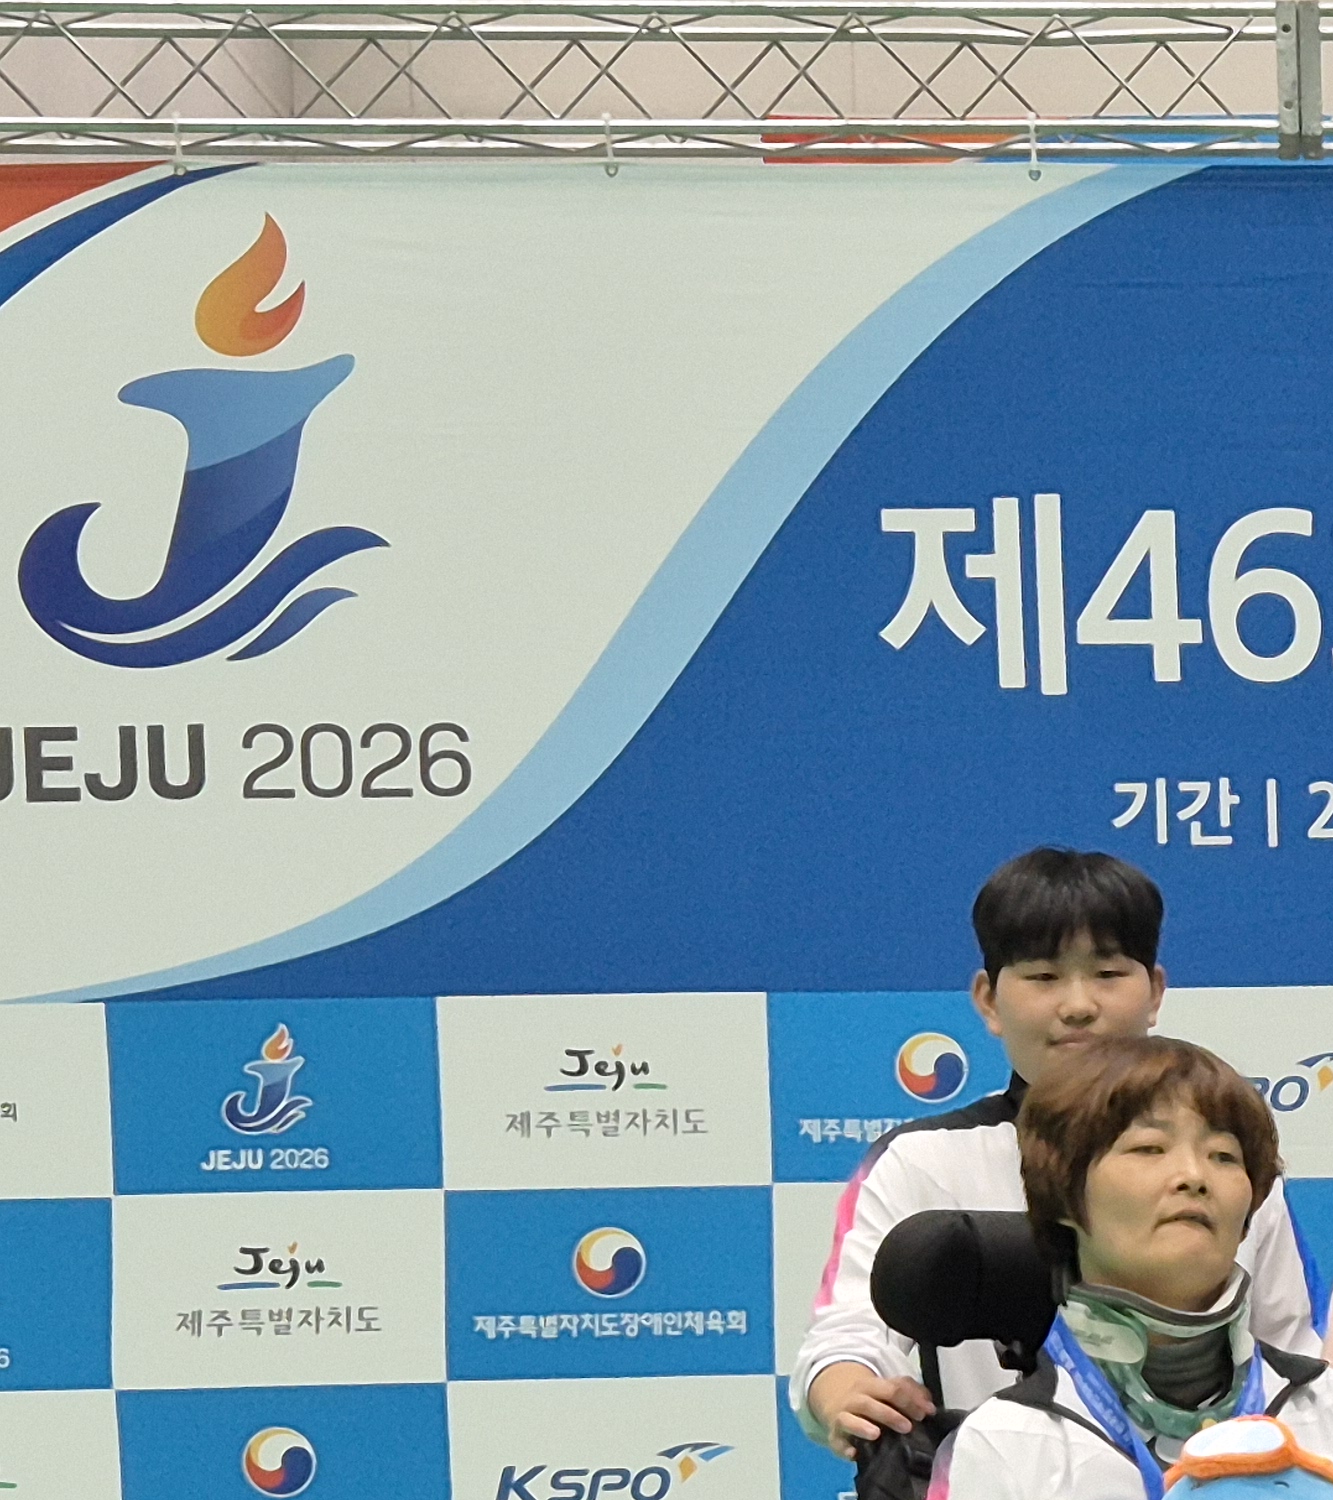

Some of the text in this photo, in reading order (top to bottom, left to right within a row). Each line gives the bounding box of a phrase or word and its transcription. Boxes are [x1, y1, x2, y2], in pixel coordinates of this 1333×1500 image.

[0, 722, 472, 803] EJU 2026
[1111, 776, 1241, 846] 기간
[558, 1044, 650, 1092] Jeju
[505, 1107, 709, 1139] 제주특별자치도
[200, 1147, 330, 1171] JEJU 2026
[232, 1242, 326, 1290] Jeju
[175, 1305, 382, 1338] 제주특별자치도
[473, 1309, 747, 1340] 제주특별자치도장애인체육회
